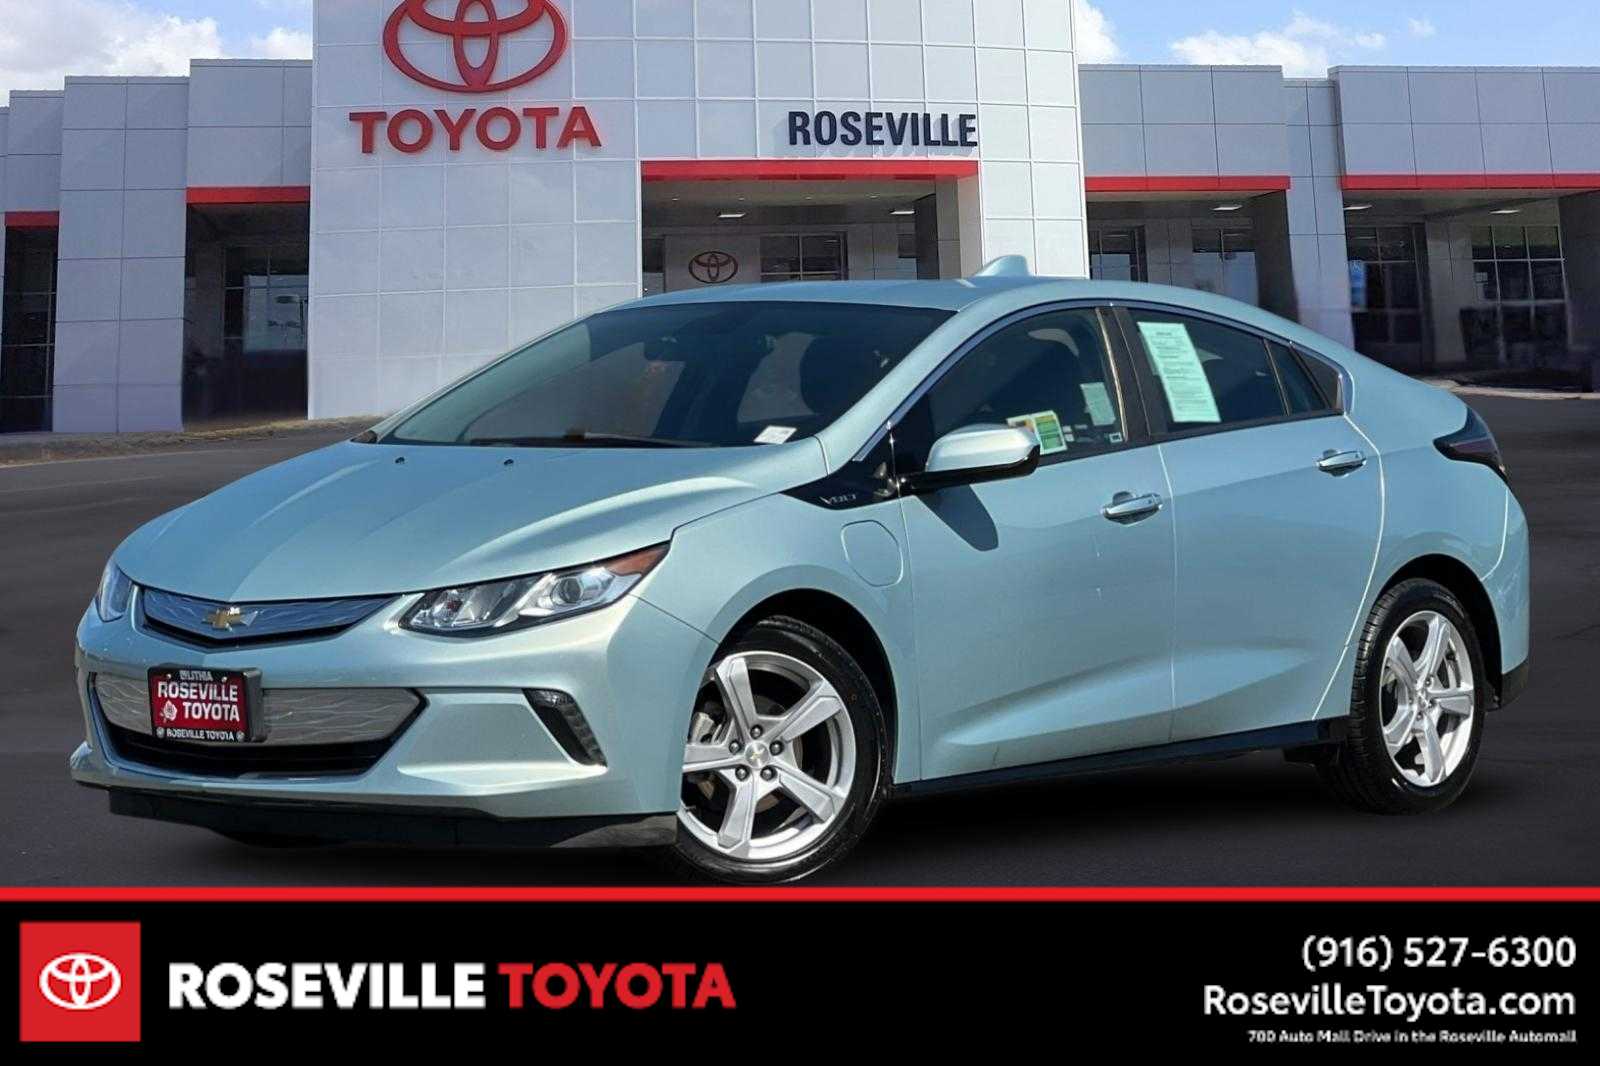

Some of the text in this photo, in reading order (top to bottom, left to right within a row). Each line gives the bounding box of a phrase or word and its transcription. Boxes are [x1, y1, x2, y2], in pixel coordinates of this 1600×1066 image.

[349, 106, 602, 154] TOYOTA
[788, 110, 978, 147] ROSEVILLE
[158, 681, 238, 702] ROSEVILLE
[182, 701, 240, 722] TOYOTA
[166, 727, 234, 741] ROSEVILLE TOYOTA
